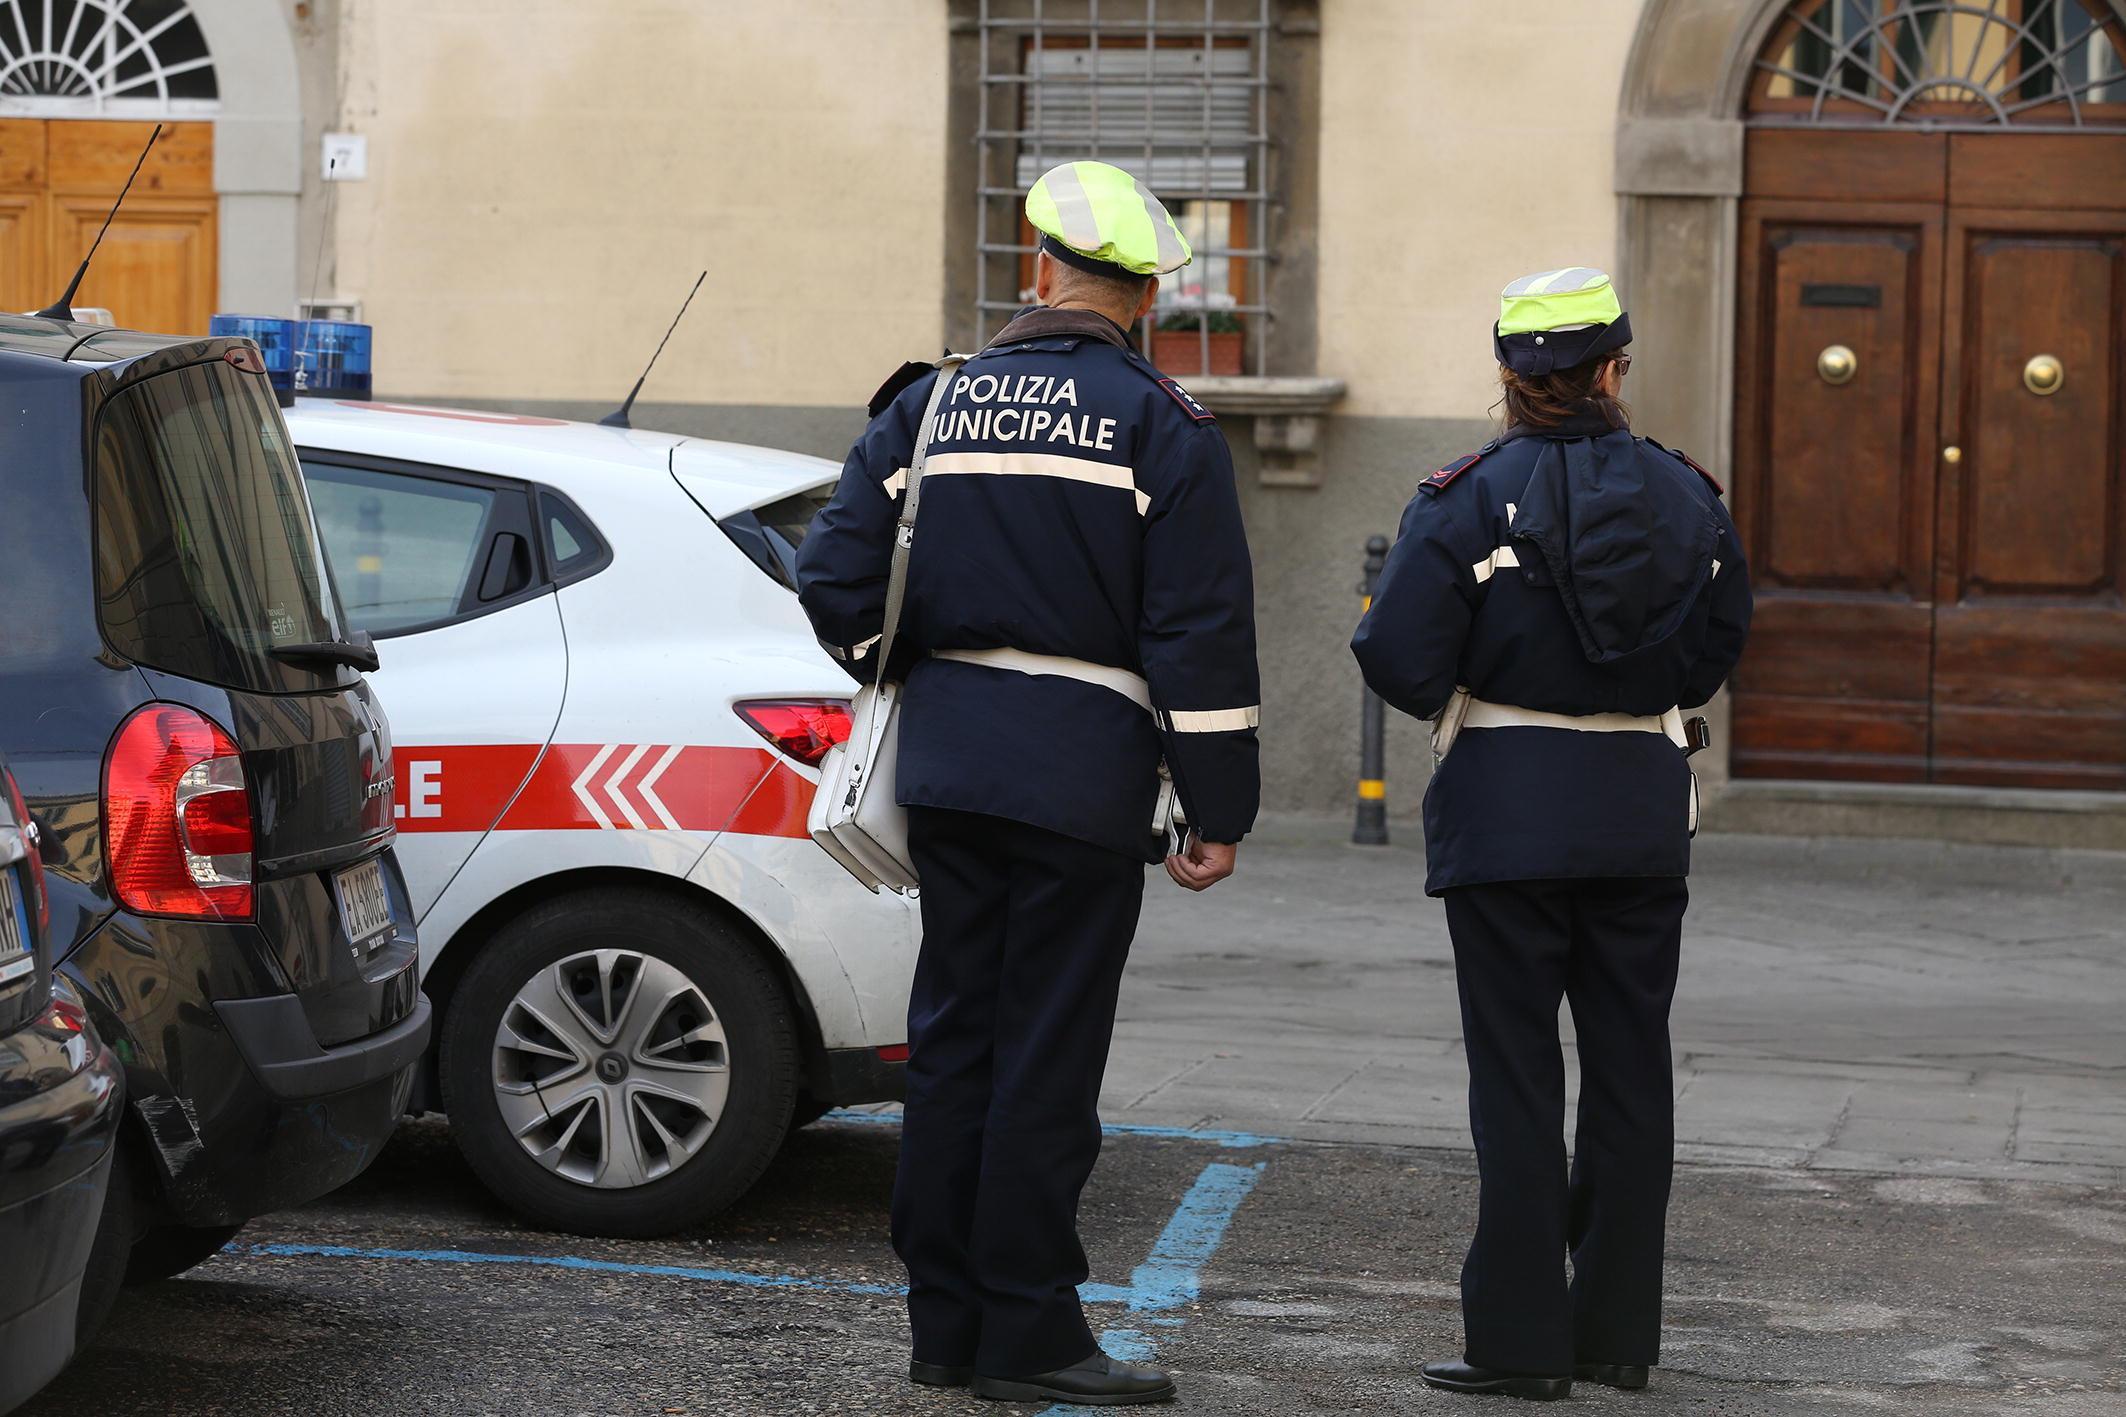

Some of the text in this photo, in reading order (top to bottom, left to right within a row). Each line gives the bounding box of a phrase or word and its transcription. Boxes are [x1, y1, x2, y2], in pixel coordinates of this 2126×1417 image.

[336, 148, 352, 169] 7
[950, 374, 1078, 407] POLIZIA
[394, 760, 442, 818] E
